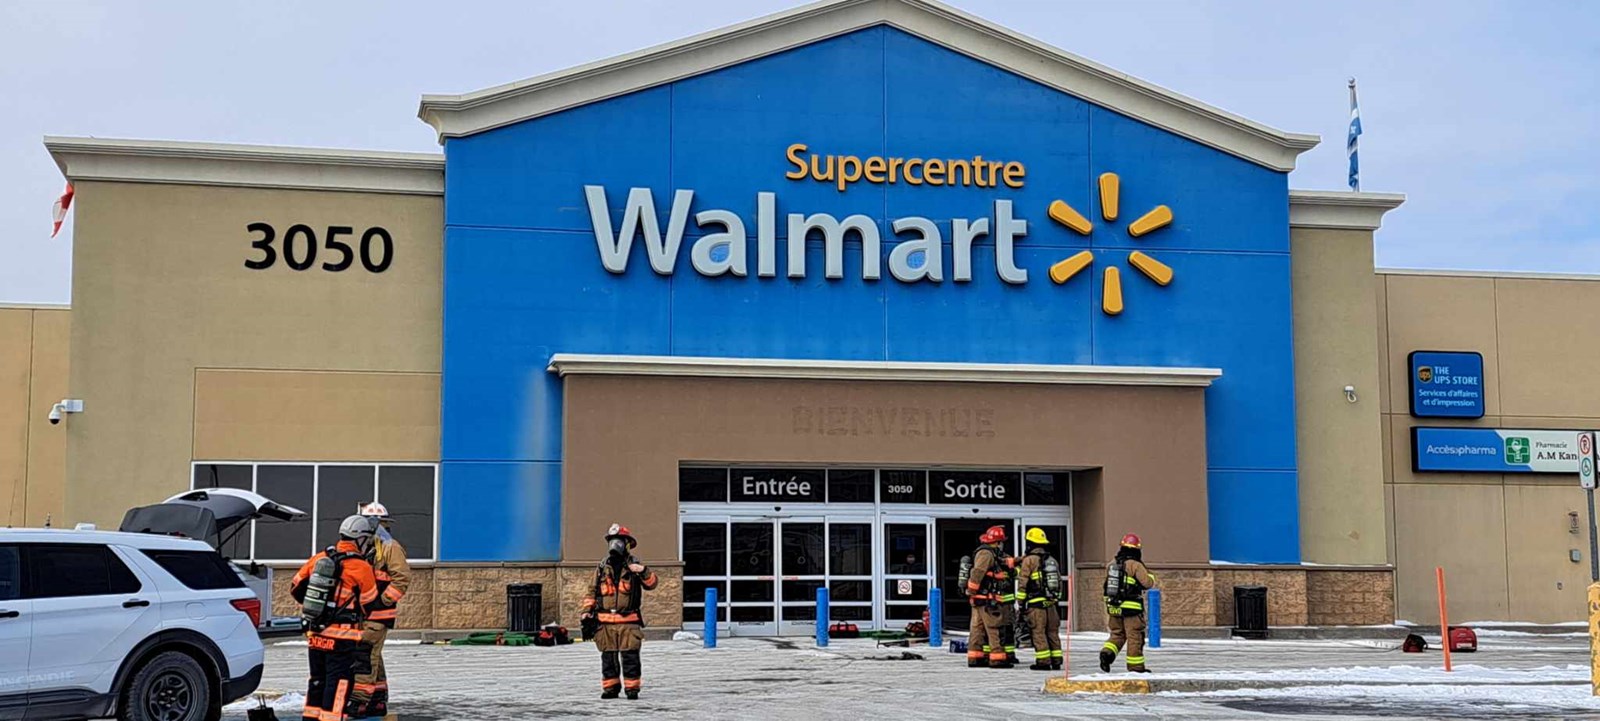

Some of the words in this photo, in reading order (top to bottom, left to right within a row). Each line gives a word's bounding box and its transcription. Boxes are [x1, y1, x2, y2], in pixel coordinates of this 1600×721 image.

[785, 144, 1026, 191] Supercentre
[584, 185, 1028, 284] Walmart
[244, 222, 394, 273] 3050
[1434, 366, 1450, 375] THE
[1434, 376, 1451, 385] UPS
[1452, 376, 1479, 385] STORE
[1418, 389, 1447, 397] Services
[1447, 389, 1479, 398] d'affaires
[1431, 399, 1476, 408] d'impression
[792, 405, 996, 438] BIENVENUE
[1535, 441, 1568, 449] Pharmacie
[1537, 451, 1557, 461] A.M
[743, 476, 811, 496] Entrée
[888, 485, 913, 494] 3050
[944, 479, 1006, 499] Sortie
